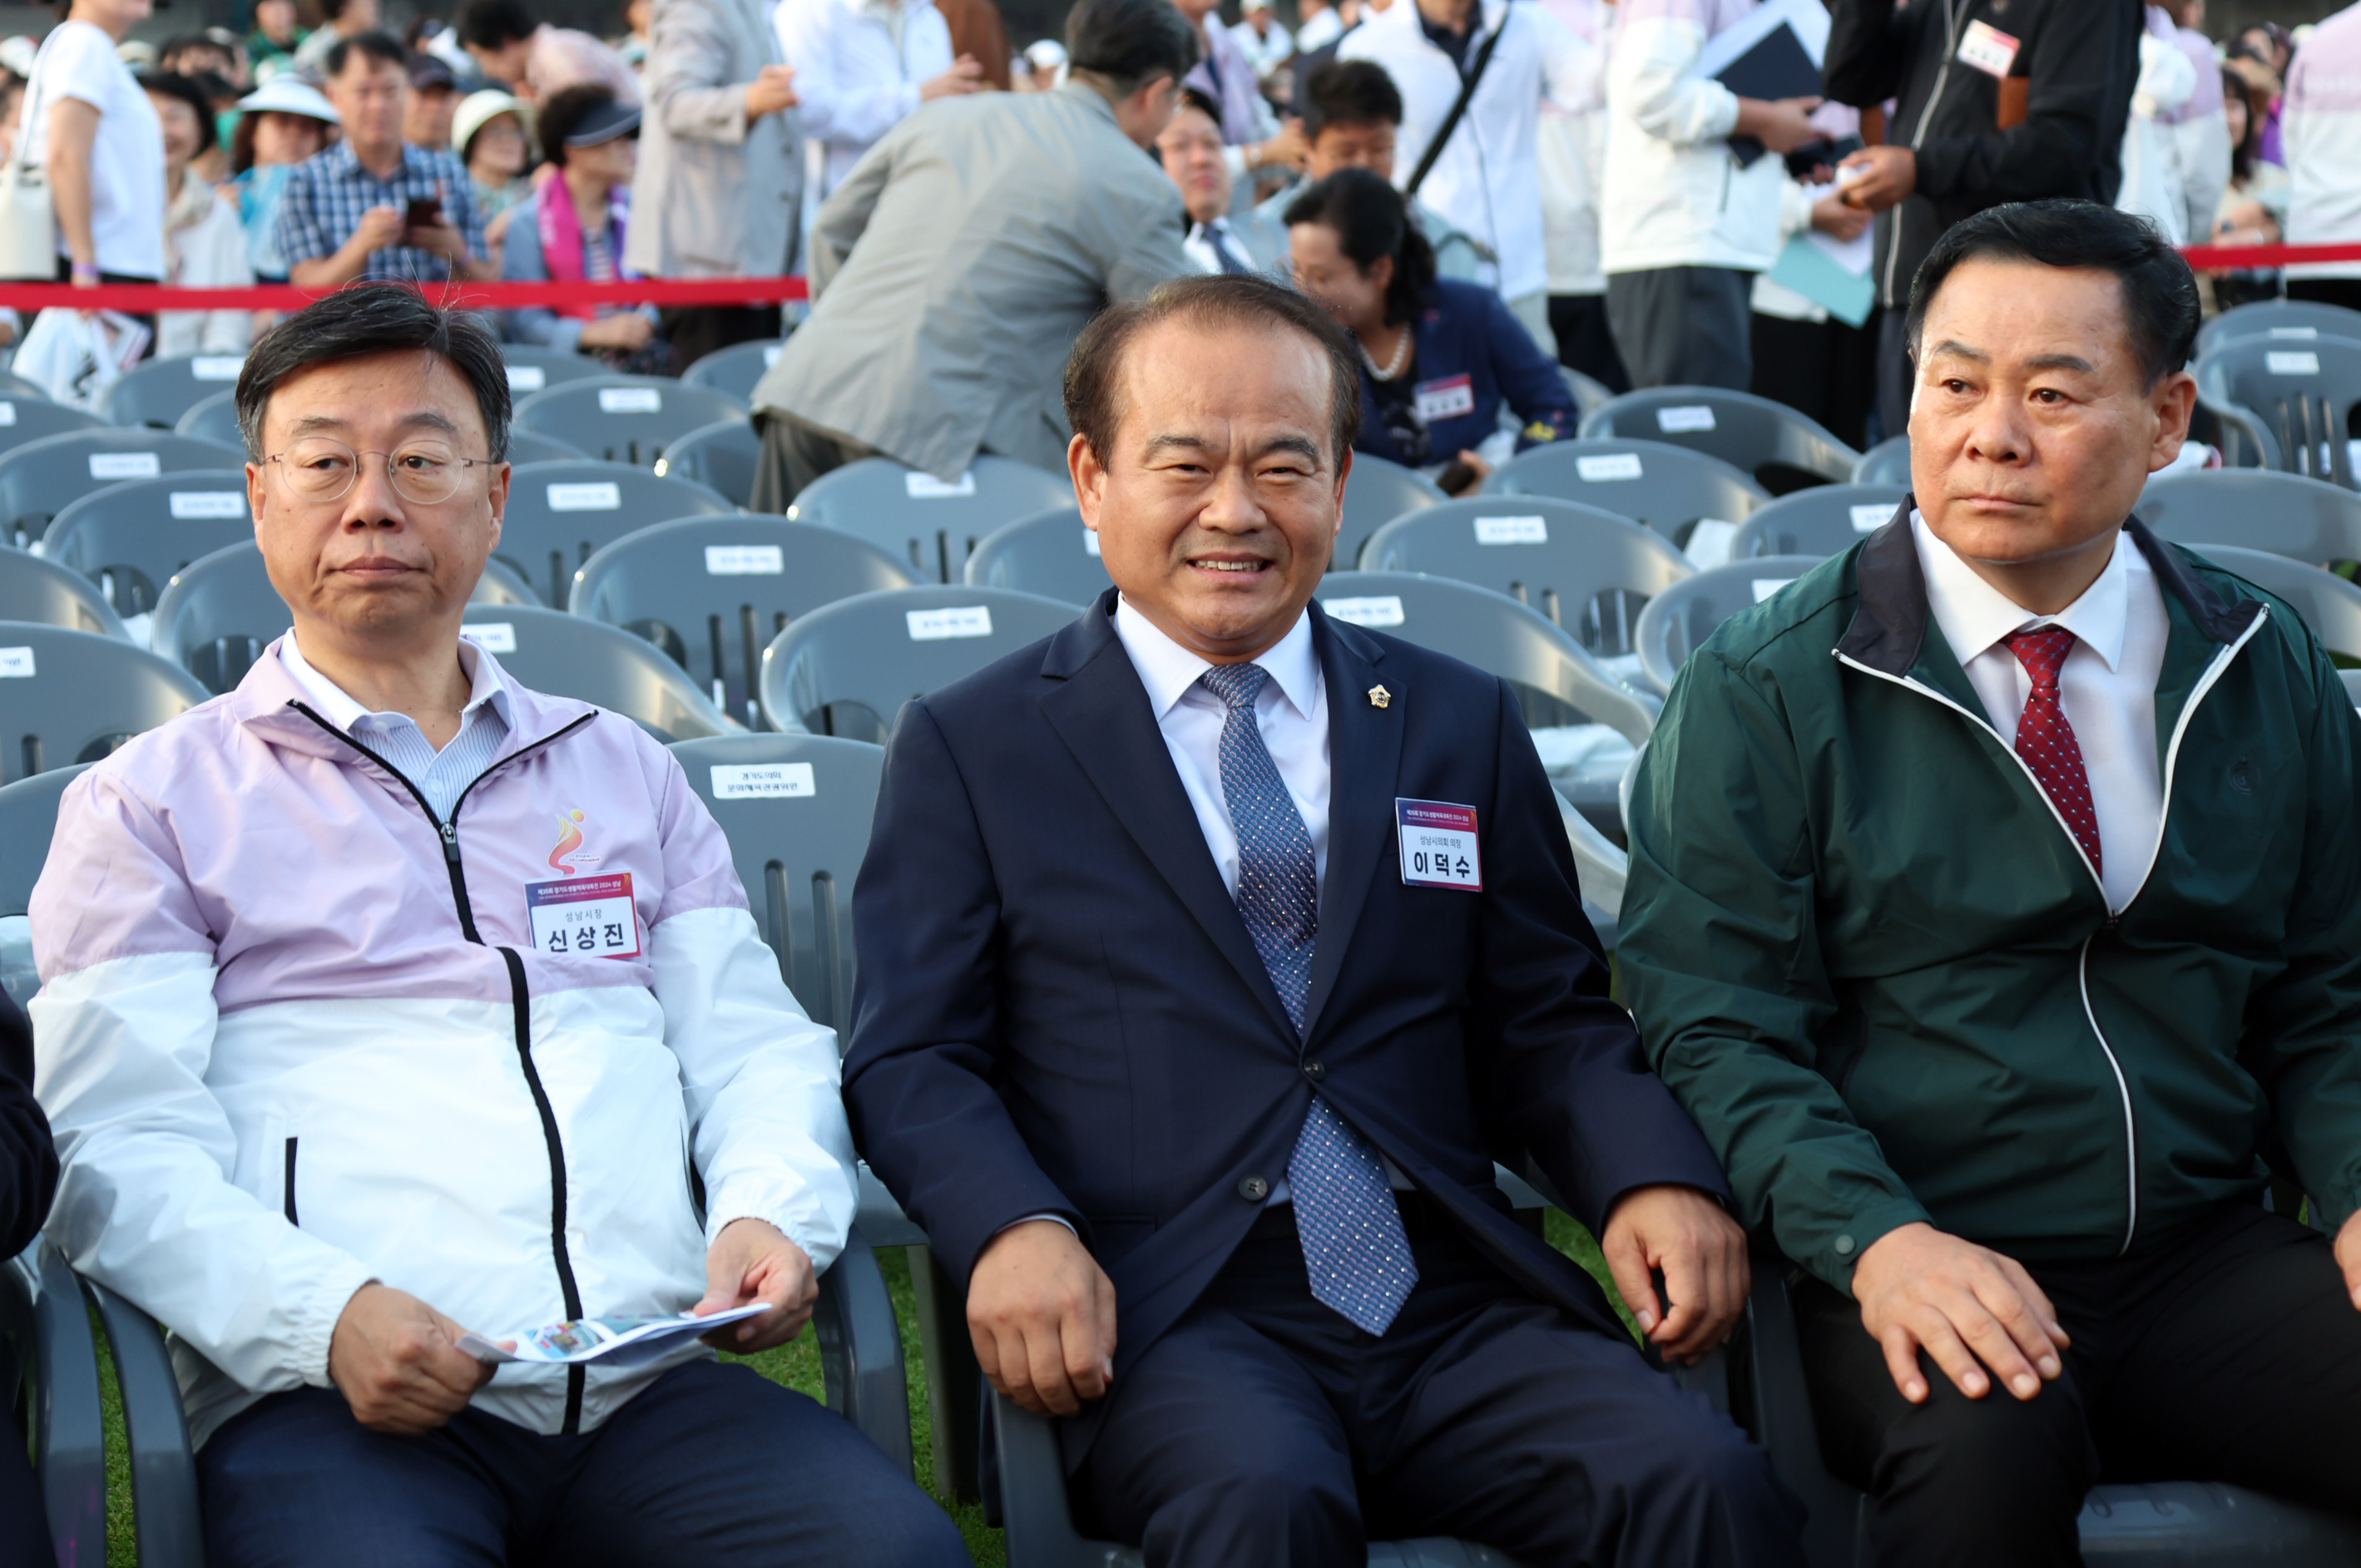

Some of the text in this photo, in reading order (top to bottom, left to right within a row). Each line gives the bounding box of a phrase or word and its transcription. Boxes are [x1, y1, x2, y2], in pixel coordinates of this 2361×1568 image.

[1420, 835, 1462, 849] 성남시의회 의장
[599, 881, 611, 889] 2024
[565, 908, 602, 922] 성남시장
